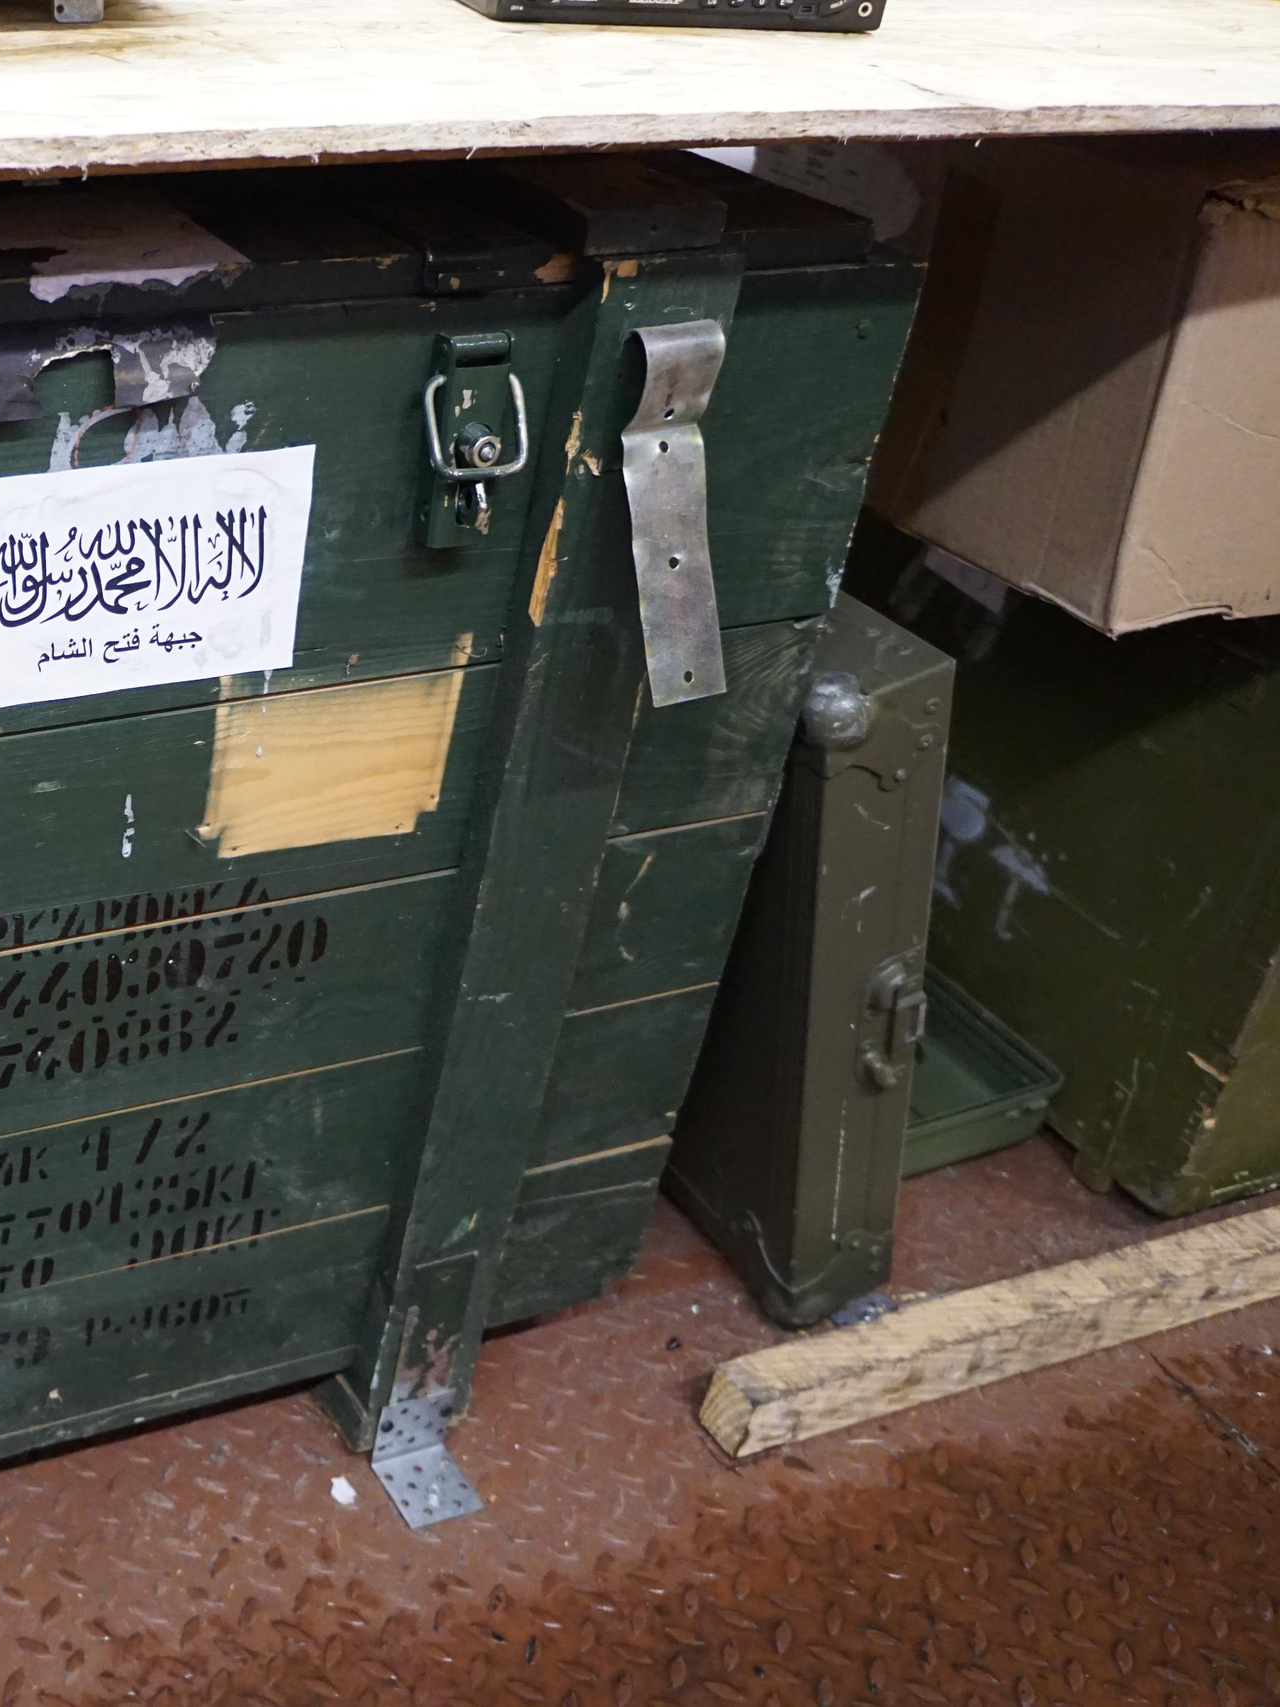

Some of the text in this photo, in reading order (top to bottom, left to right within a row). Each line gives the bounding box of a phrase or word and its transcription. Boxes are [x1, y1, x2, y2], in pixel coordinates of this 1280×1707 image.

[37, 624, 202, 672] جبهة فتح الشام
